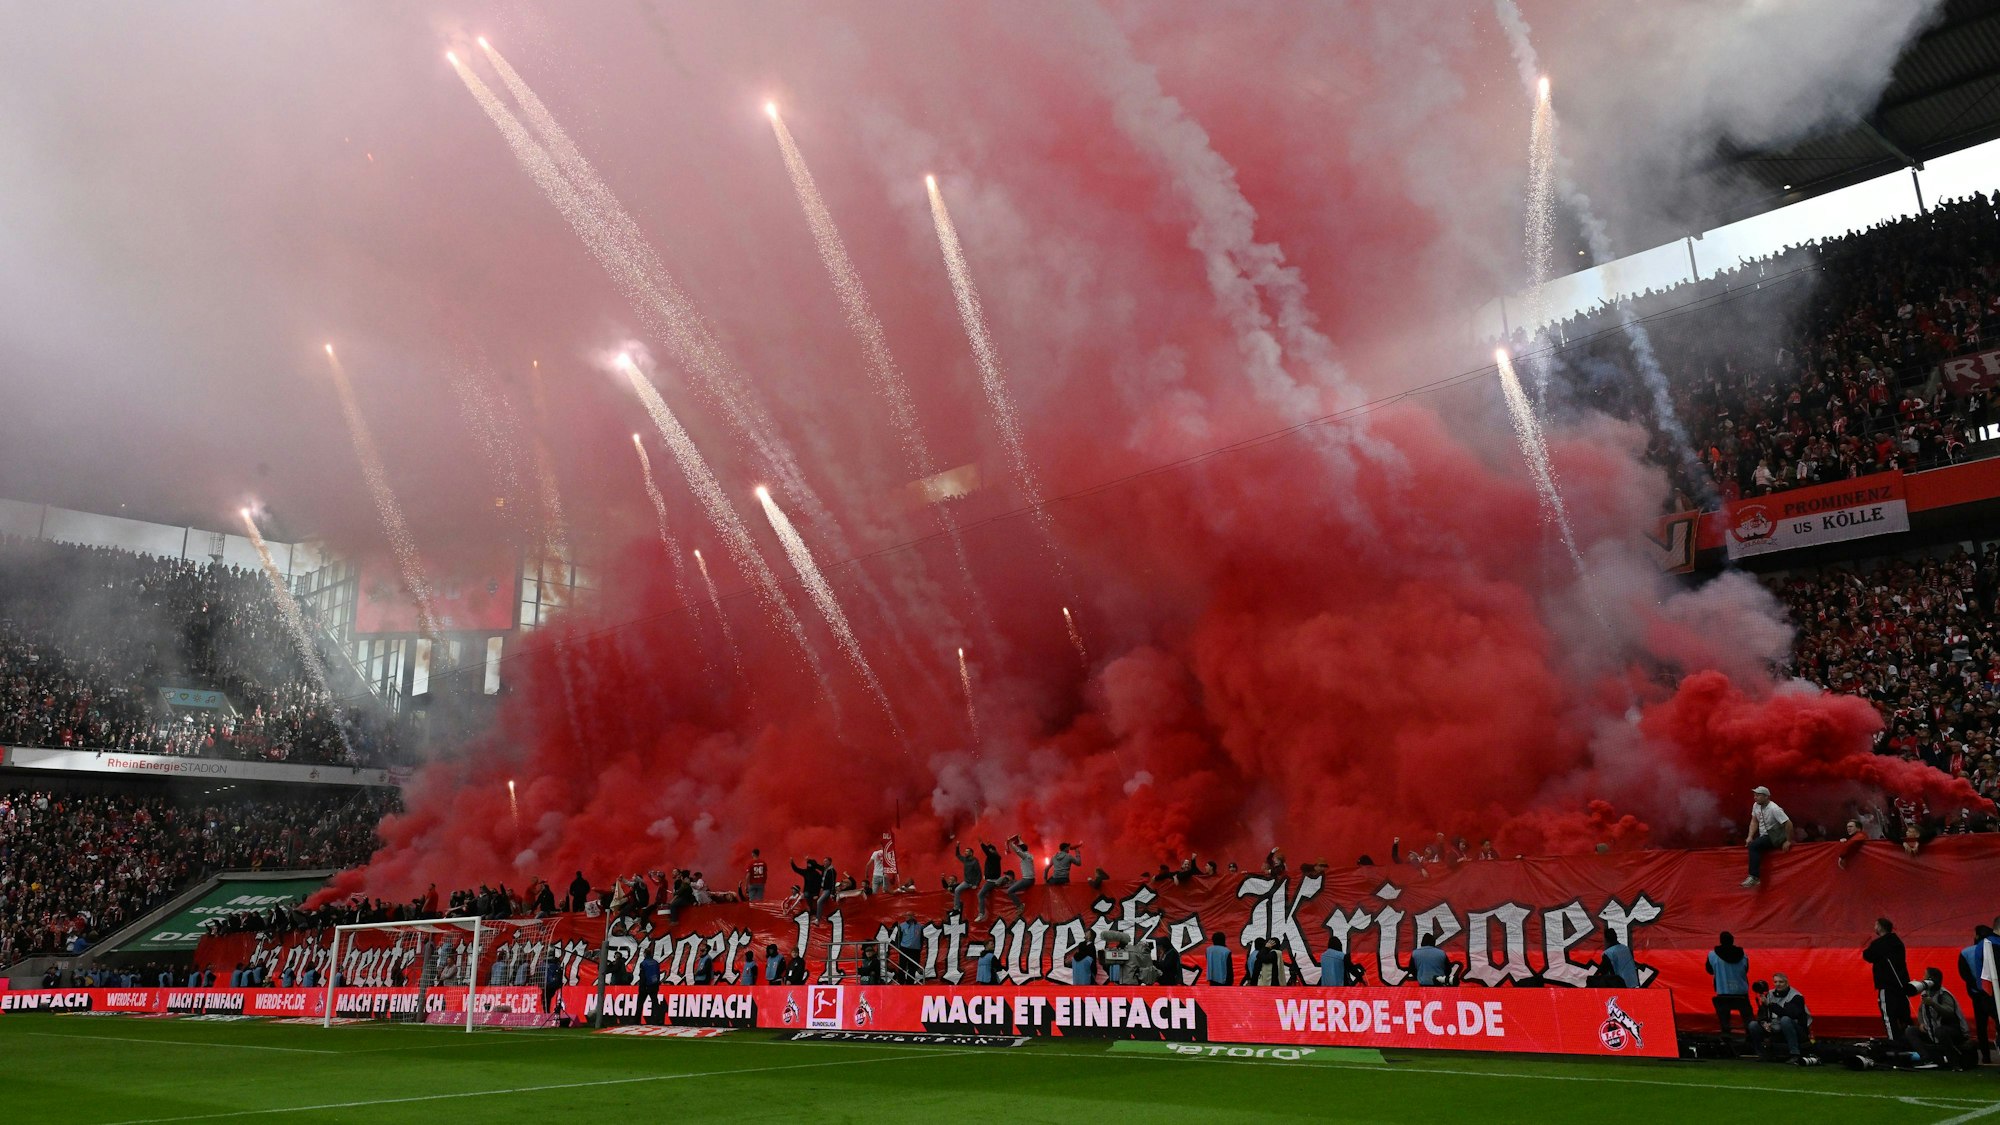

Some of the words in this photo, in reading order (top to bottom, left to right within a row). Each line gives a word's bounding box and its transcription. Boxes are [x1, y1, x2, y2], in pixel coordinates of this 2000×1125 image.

[1784, 487, 1892, 515] PROMINENZ
[1822, 507, 1885, 530] KÖLLE
[107, 758, 227, 774] RheinEnergieSTADION
[593, 915, 751, 986] Sieger
[1238, 876, 1662, 987] Krieger
[1, 993, 88, 1010] EINFACH
[107, 993, 147, 1006] WERDE-FC.DE
[167, 993, 193, 1008] MACH
[193, 993, 205, 1009] ET
[205, 993, 244, 1010] EINFACH
[255, 993, 306, 1010] WERDE-FC.DE
[336, 993, 373, 1012] MACH
[373, 994, 388, 1012] ET
[389, 993, 444, 1013] EINFCH
[668, 994, 753, 1019] EINFACH
[921, 995, 1004, 1025] MACH
[1014, 996, 1047, 1027] ET
[1055, 996, 1196, 1030] EINFACH
[1276, 998, 1505, 1037] WERDE-FC.DE
